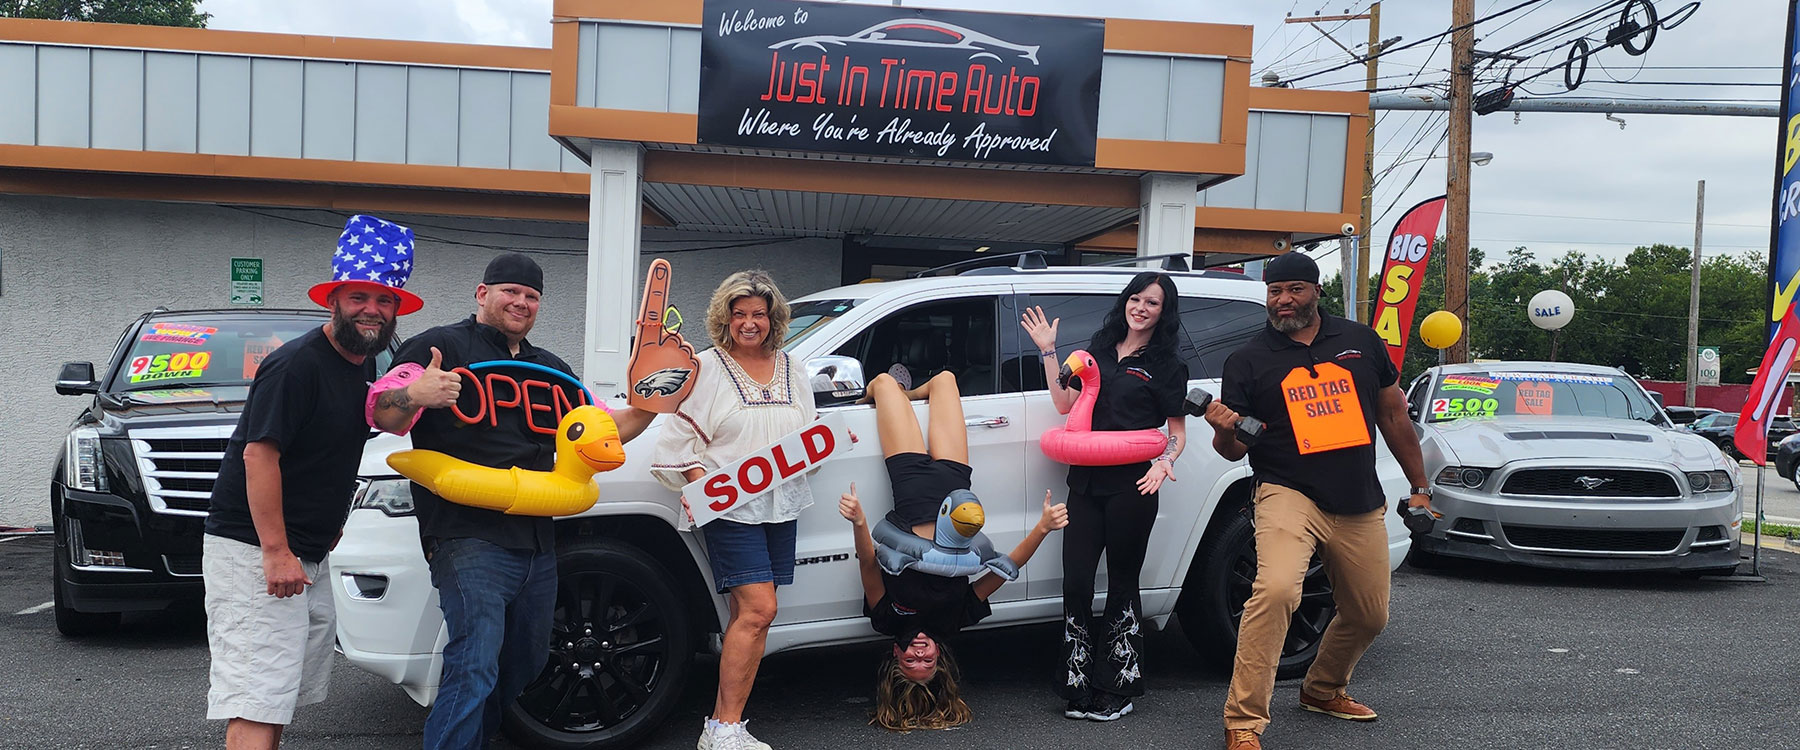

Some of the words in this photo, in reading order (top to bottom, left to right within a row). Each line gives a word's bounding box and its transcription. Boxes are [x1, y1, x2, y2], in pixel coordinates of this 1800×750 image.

[719, 9, 786, 37] Welcome
[793, 7, 809, 25] to
[760, 51, 831, 104] Just
[837, 56, 869, 107] In
[879, 58, 958, 113] Time
[962, 64, 1040, 117] Auto
[738, 108, 801, 136] Where
[812, 112, 870, 142] You're
[876, 117, 957, 157] Already
[962, 122, 1058, 159] Approved
[1389, 233, 1428, 264] BIG
[235, 267, 259, 275] PARKING
[1534, 305, 1562, 318] SALE
[246, 344, 264, 354] RED
[131, 351, 211, 375] 9500
[140, 370, 192, 381] DOWN
[1701, 368, 1717, 378] 100
[1287, 384, 1319, 403] RED
[1319, 379, 1350, 397] TAG
[1519, 389, 1534, 397] RED
[1536, 390, 1551, 398] TAG
[450, 367, 586, 435] OPEN
[1433, 398, 1499, 412] 2500
[1525, 398, 1544, 407] SALE
[1305, 399, 1343, 418] SALE
[1303, 438, 1311, 449] $
[704, 424, 836, 512] SOLD
[794, 553, 849, 566] GRAND
